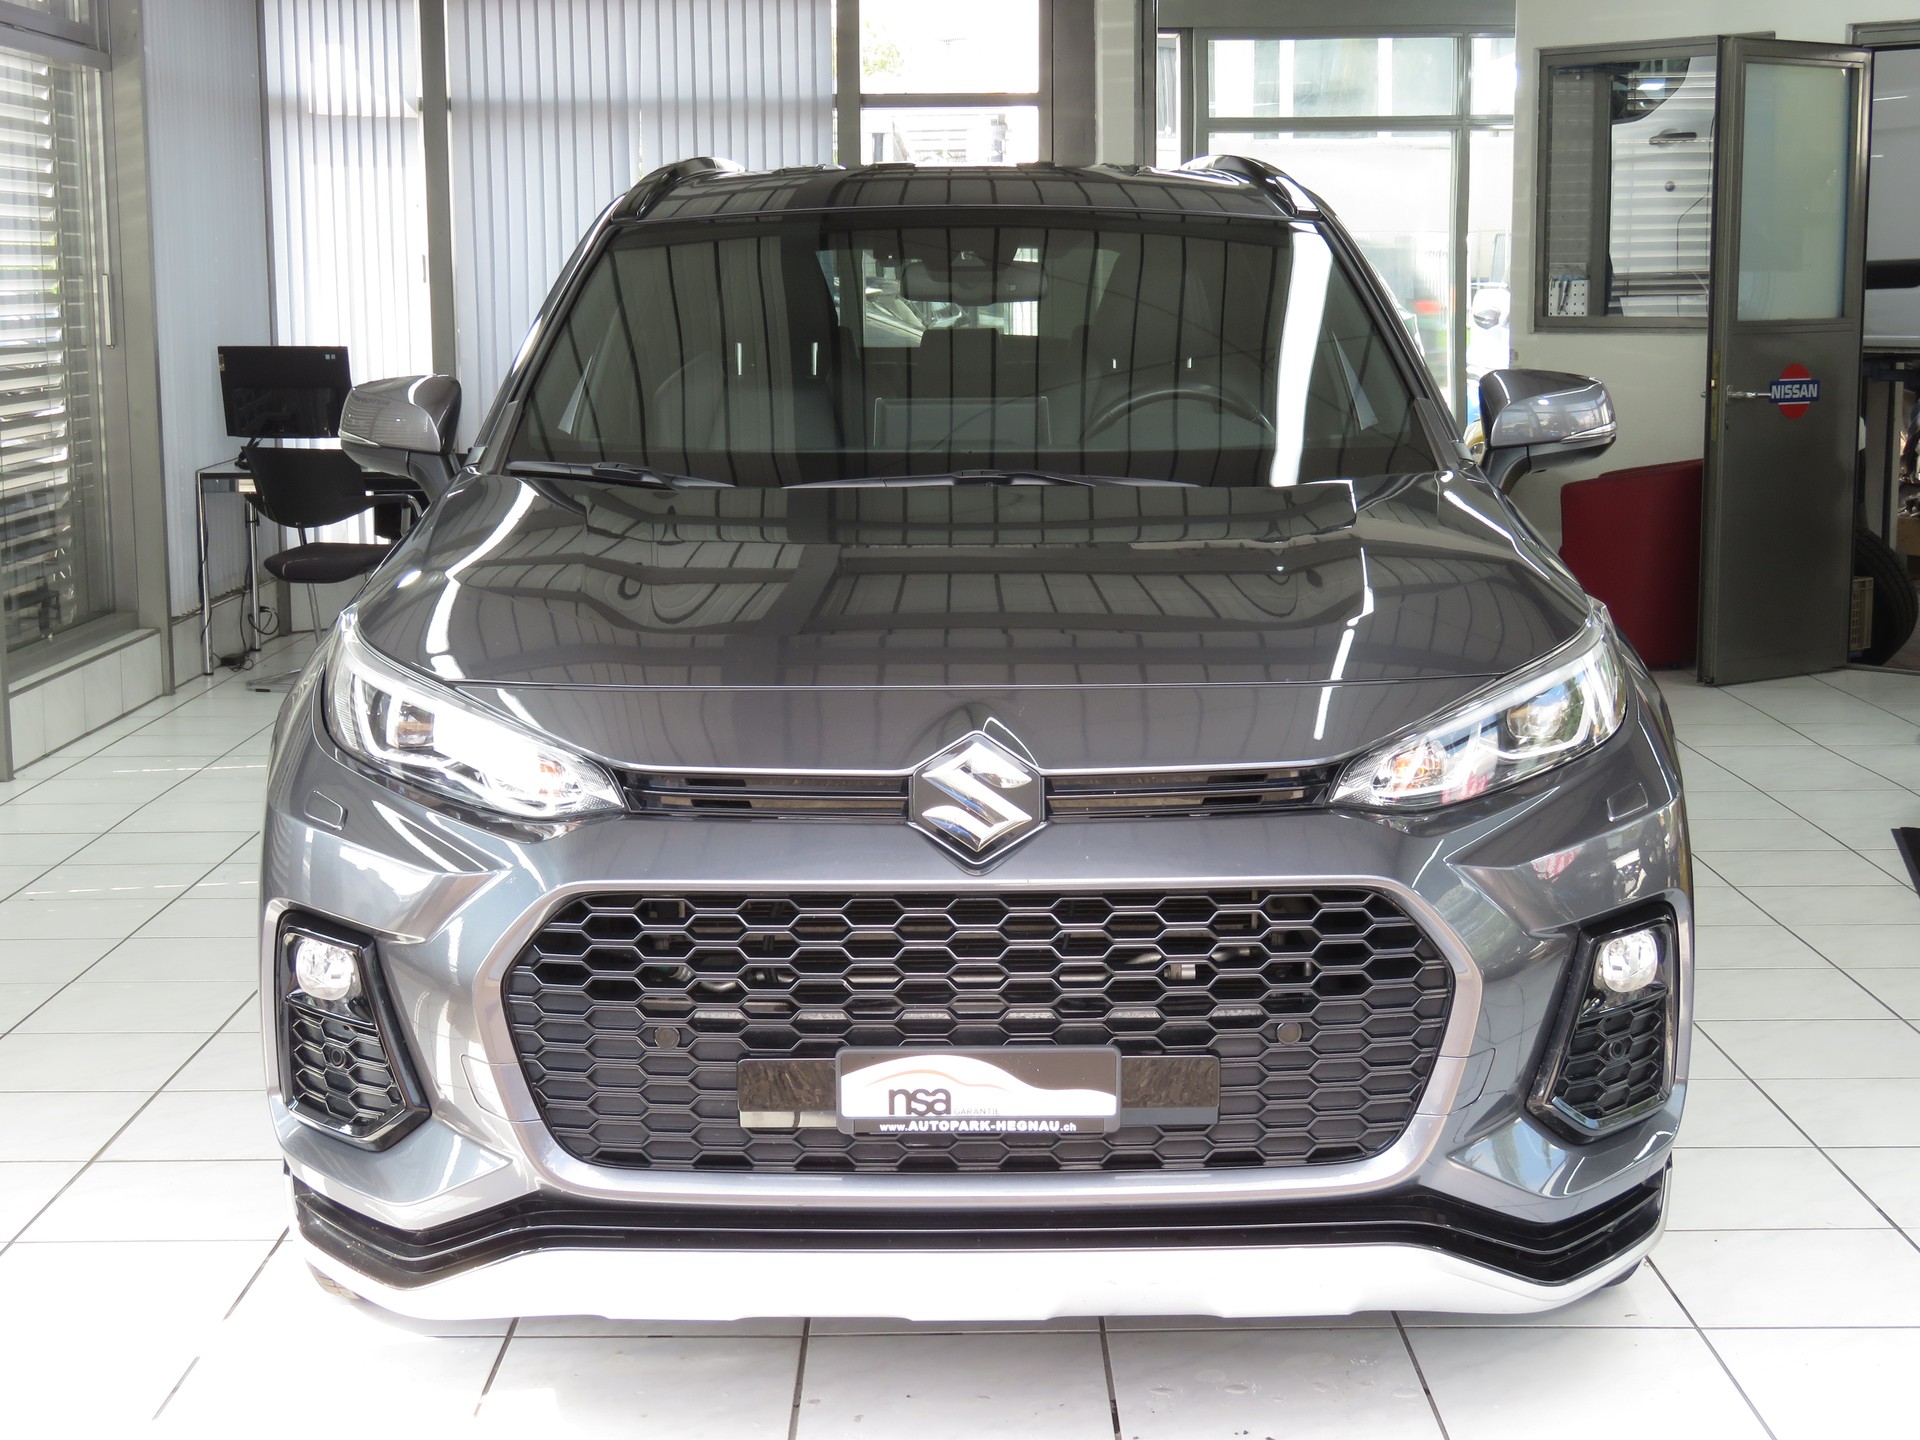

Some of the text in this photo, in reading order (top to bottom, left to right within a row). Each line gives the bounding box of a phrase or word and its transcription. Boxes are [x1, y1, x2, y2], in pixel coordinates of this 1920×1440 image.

[1771, 384, 1818, 399] NISSAN
[888, 1088, 952, 1116] nsa
[879, 1120, 1077, 1132] www.AUTOPARK-HEGNAU.ch
